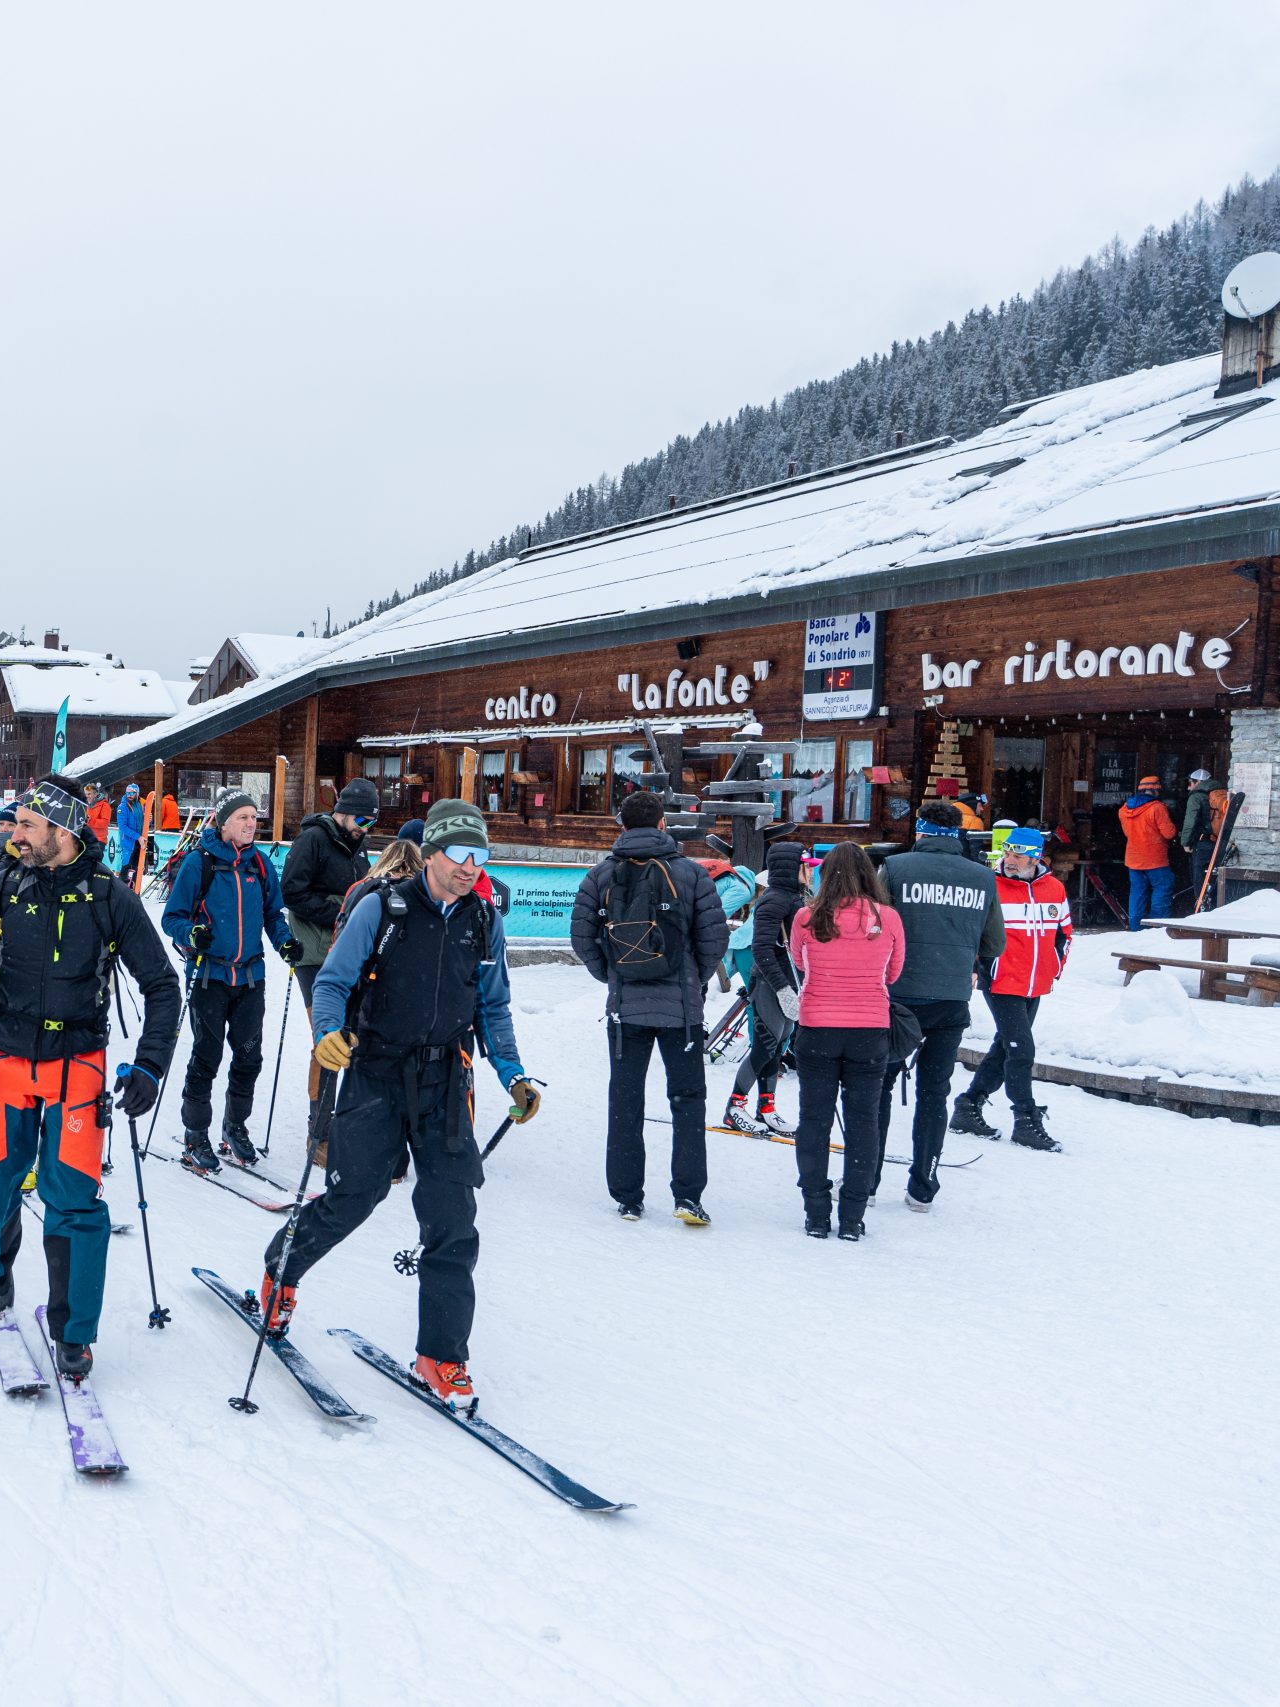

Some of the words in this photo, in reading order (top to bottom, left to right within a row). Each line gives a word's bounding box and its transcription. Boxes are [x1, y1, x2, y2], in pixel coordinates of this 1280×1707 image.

[809, 617, 836, 630] Banca
[808, 631, 849, 647] Popolare
[807, 651, 816, 663] di
[819, 647, 856, 662] Sondrio
[858, 650, 871, 659] 1871
[921, 653, 981, 691] bar
[1004, 631, 1232, 685] ristorante
[484, 686, 556, 721] centro
[823, 696, 844, 705] Agenzia
[1108, 759, 1119, 768] LA
[1102, 768, 1124, 778] FONTE
[1104, 783, 1120, 791] BAR
[517, 888, 524, 896] Il
[526, 888, 550, 898] primo
[902, 882, 986, 911] LOMBARDIA
[513, 899, 532, 907] dello
[531, 909, 539, 917] in
[540, 909, 564, 918] Italia
[377, 922, 396, 955] ORTOVOX
